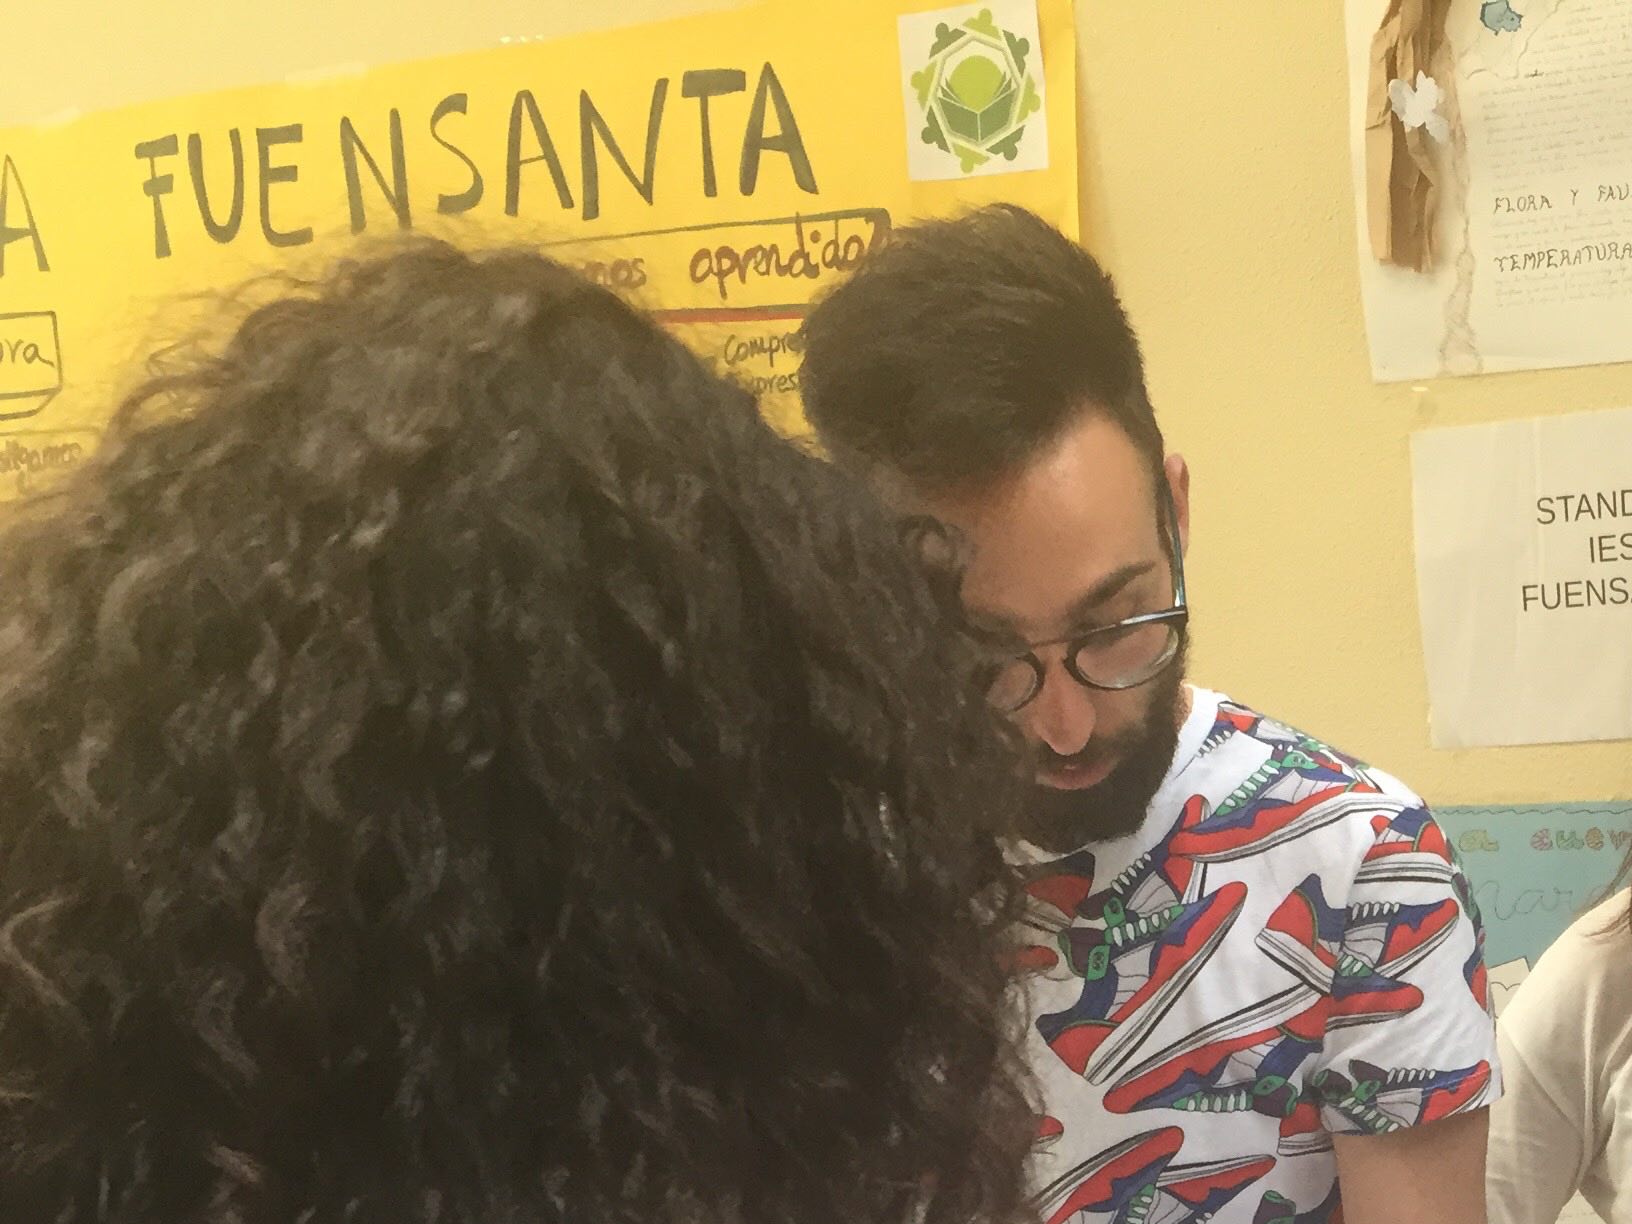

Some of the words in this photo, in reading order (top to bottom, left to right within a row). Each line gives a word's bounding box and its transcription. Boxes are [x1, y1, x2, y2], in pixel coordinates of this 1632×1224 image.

[134, 61, 820, 260] FUENSANTA
[1494, 195, 1553, 214] FLORA
[1570, 189, 1579, 206] Y
